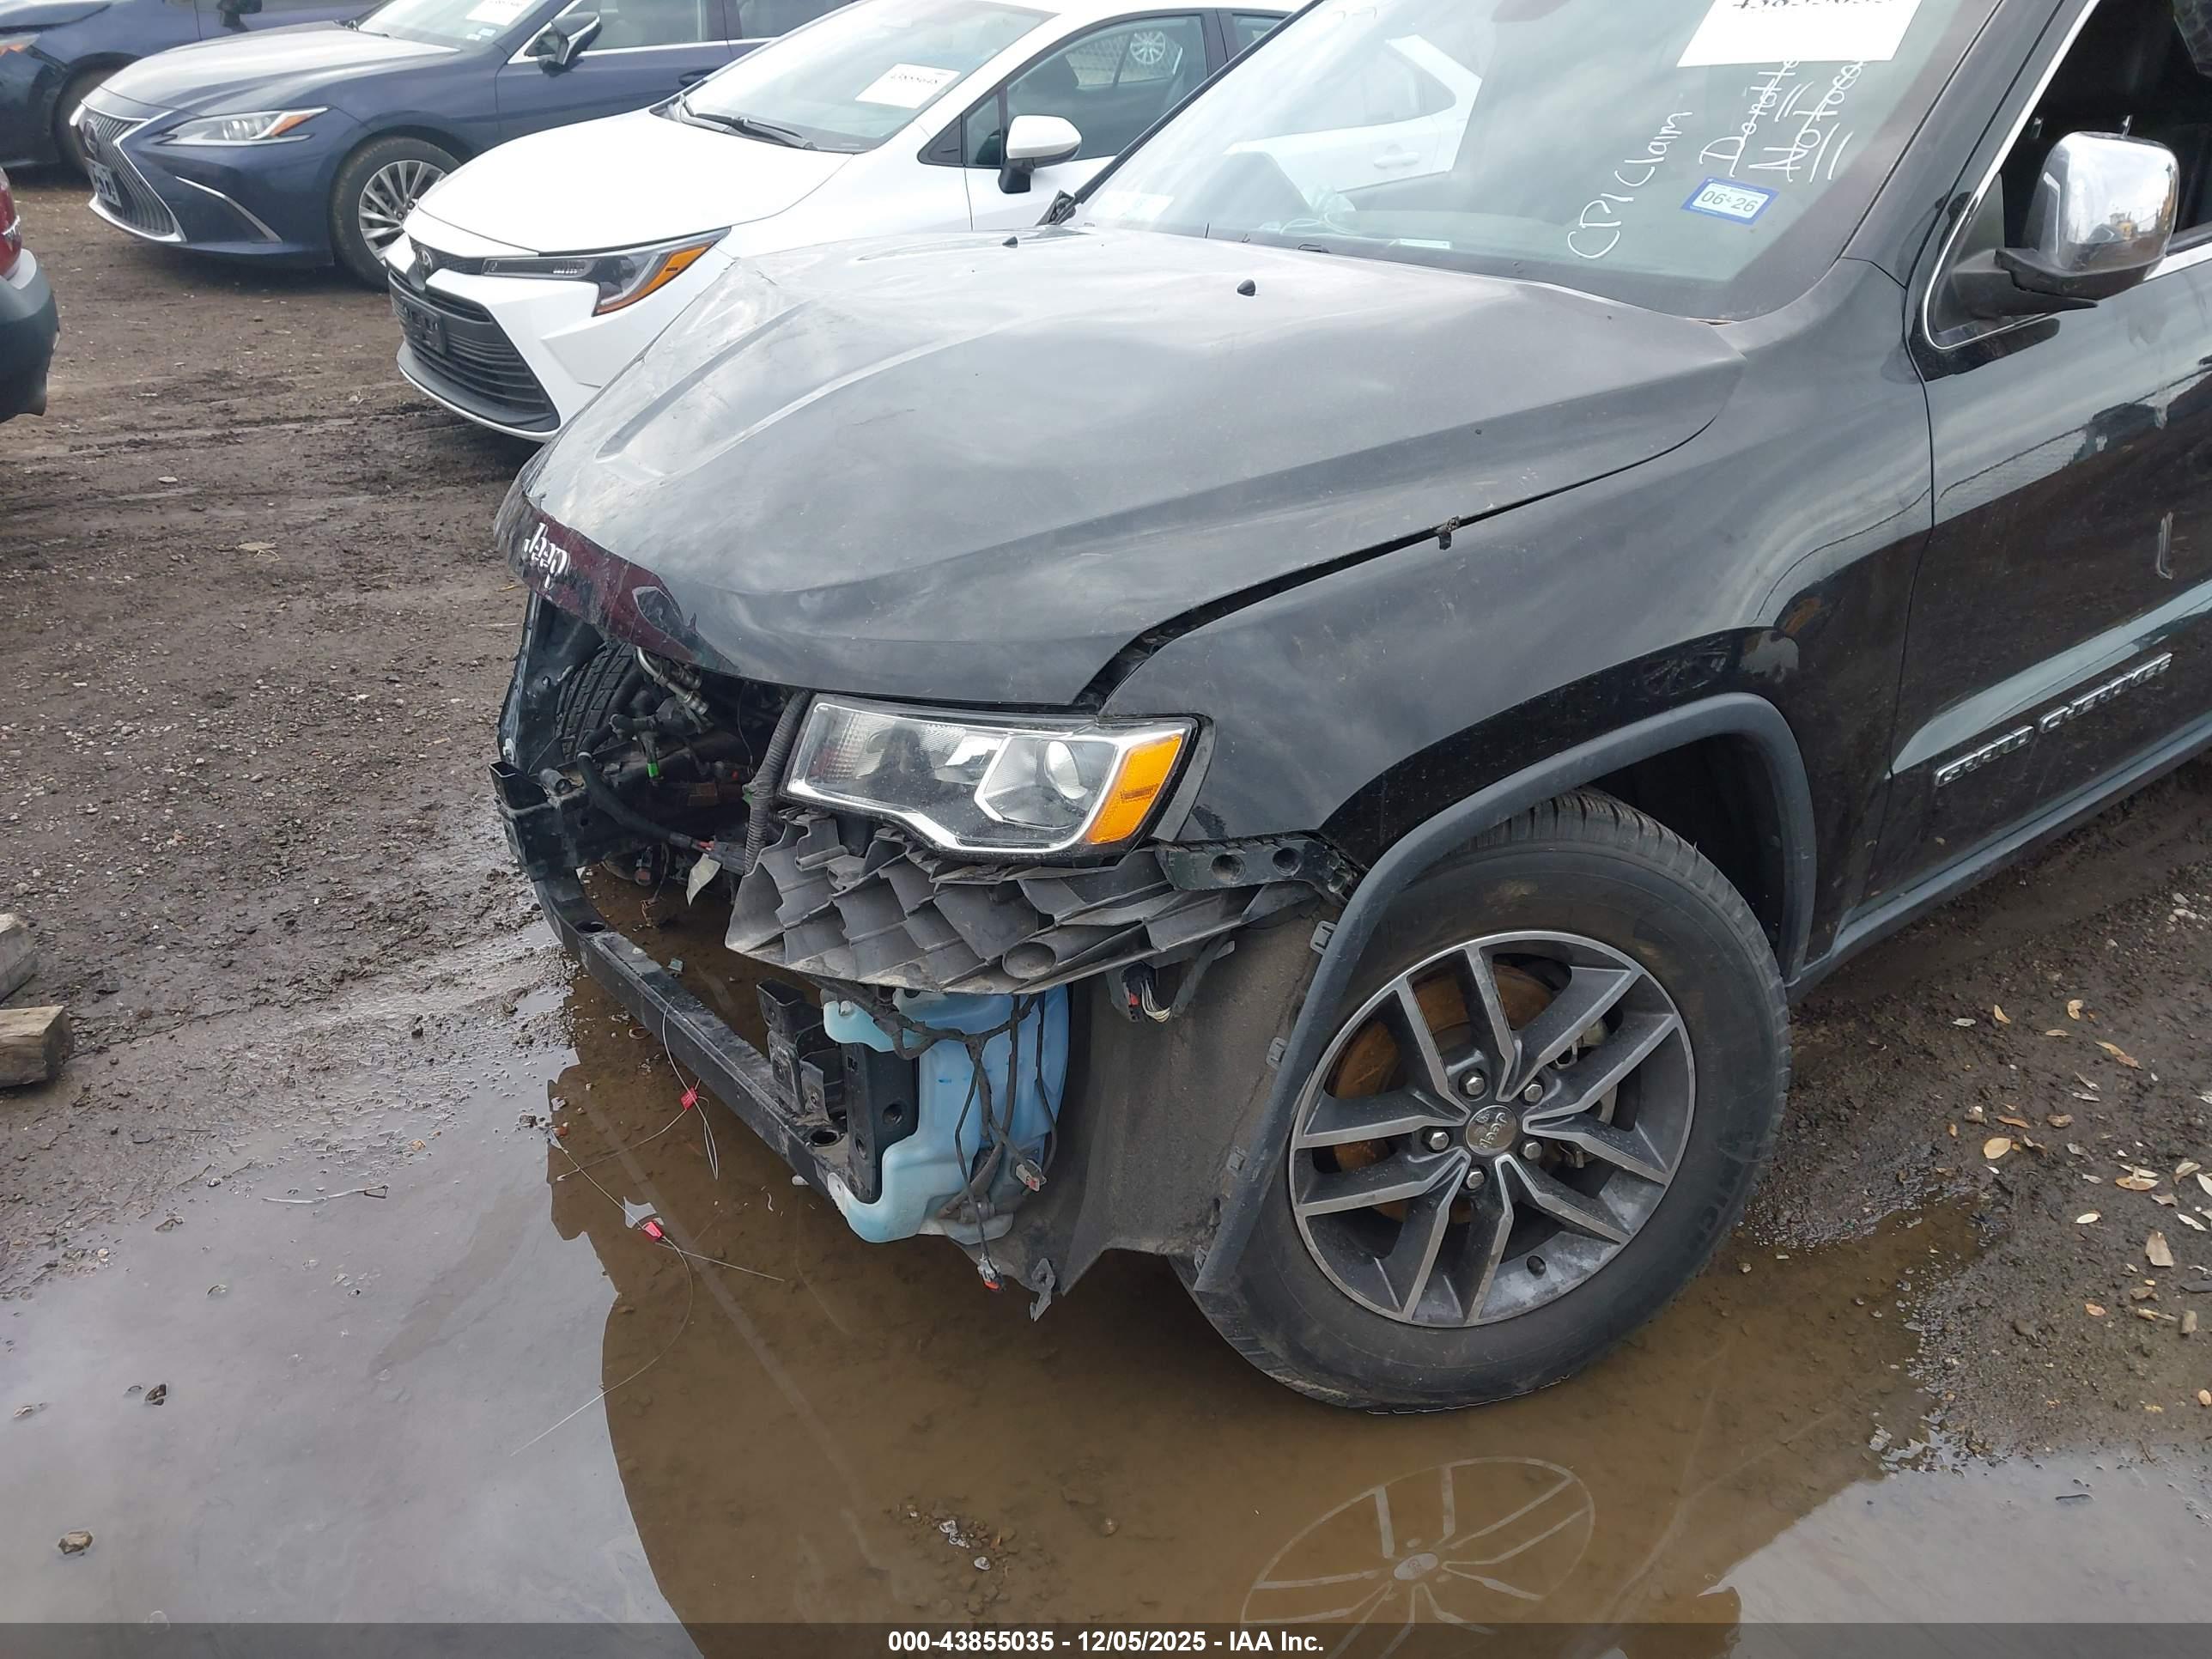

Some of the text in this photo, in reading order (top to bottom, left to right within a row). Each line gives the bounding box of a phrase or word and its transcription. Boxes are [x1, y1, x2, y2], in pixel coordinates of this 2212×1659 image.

[1567, 111, 1693, 258] CPI Claim
[1479, 1111, 1509, 1150] Jeep
